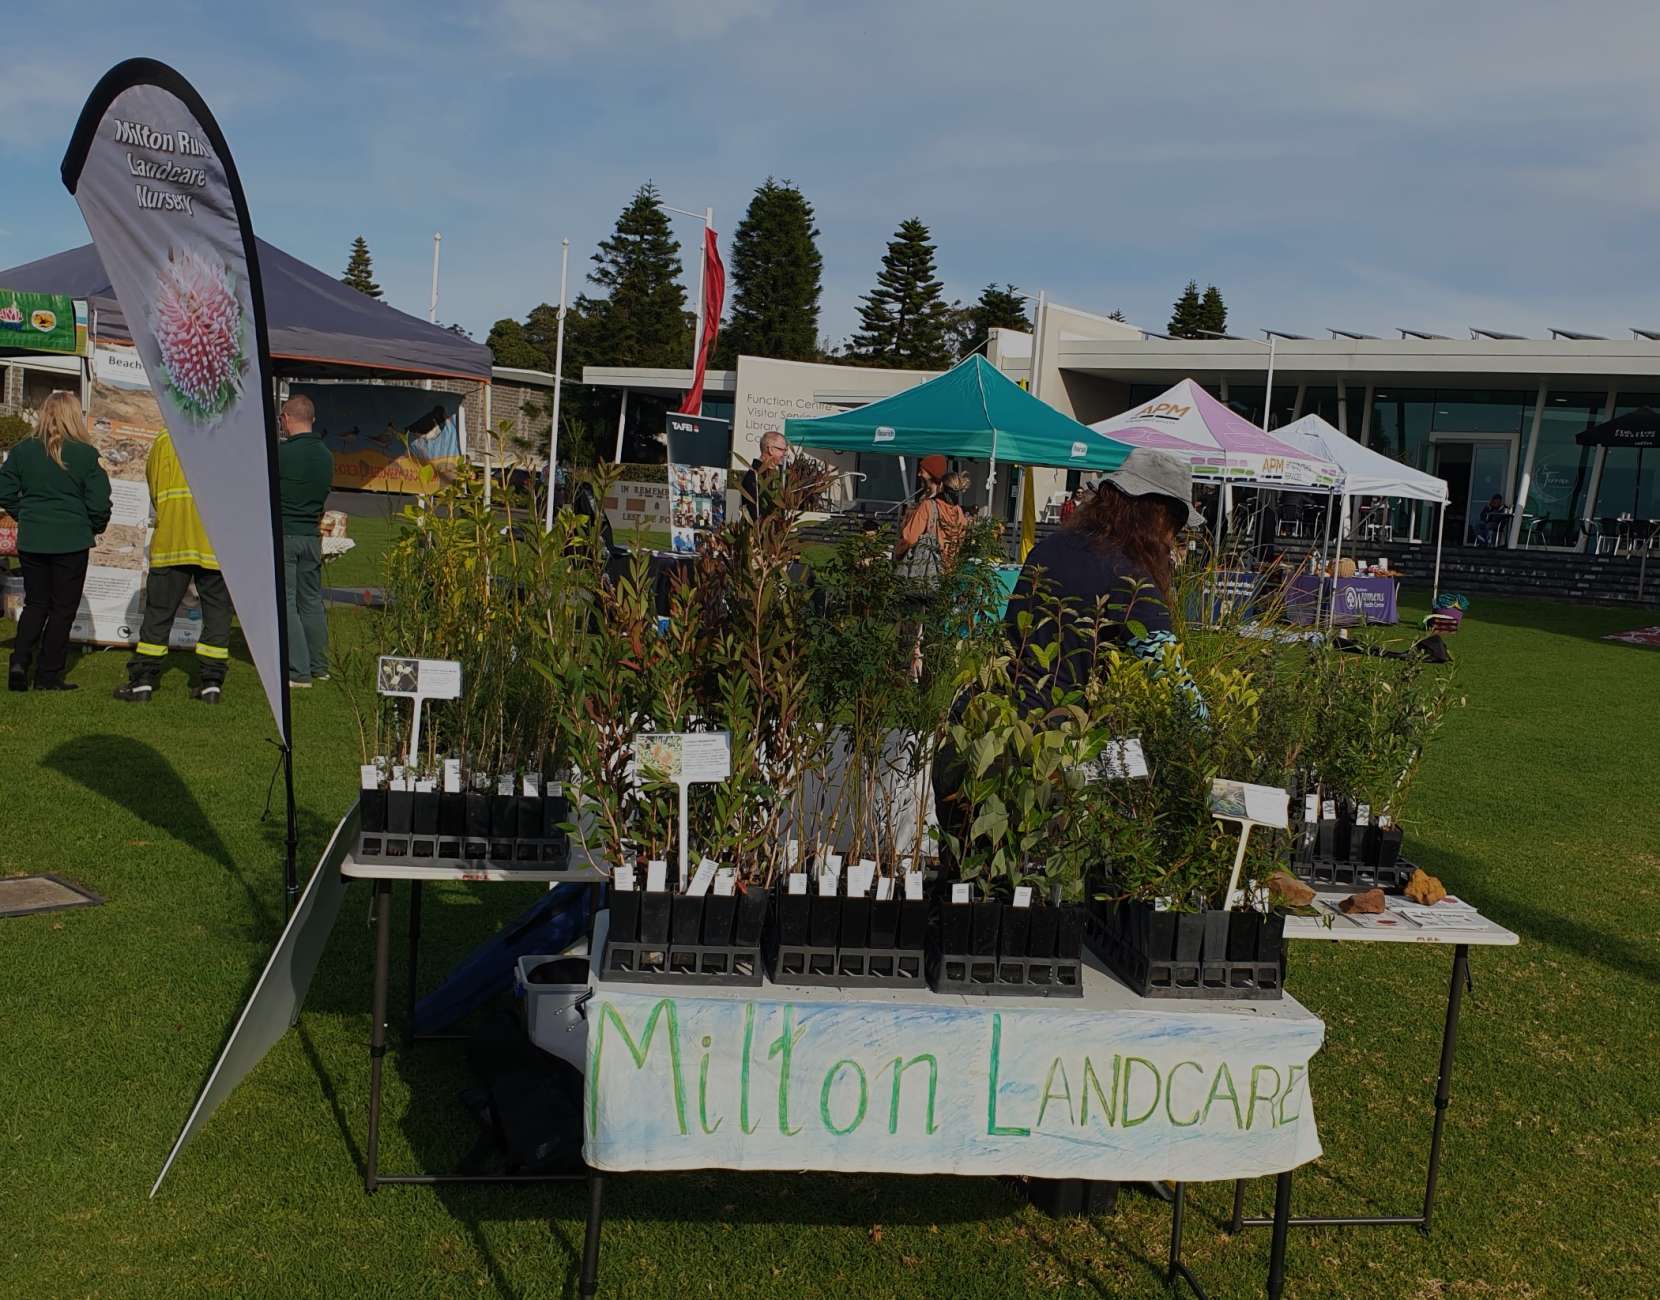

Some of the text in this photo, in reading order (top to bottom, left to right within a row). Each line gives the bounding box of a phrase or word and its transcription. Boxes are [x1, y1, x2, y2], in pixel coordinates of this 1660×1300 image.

[114, 119, 175, 153] Milton
[127, 152, 206, 187] Landcare
[136, 184, 194, 217] Nursery
[747, 393, 793, 407] Function
[747, 407, 778, 418] Visitor
[744, 420, 779, 432] Library
[1262, 456, 1285, 473] APM
[589, 998, 1306, 1139] Milton LANDCARE
